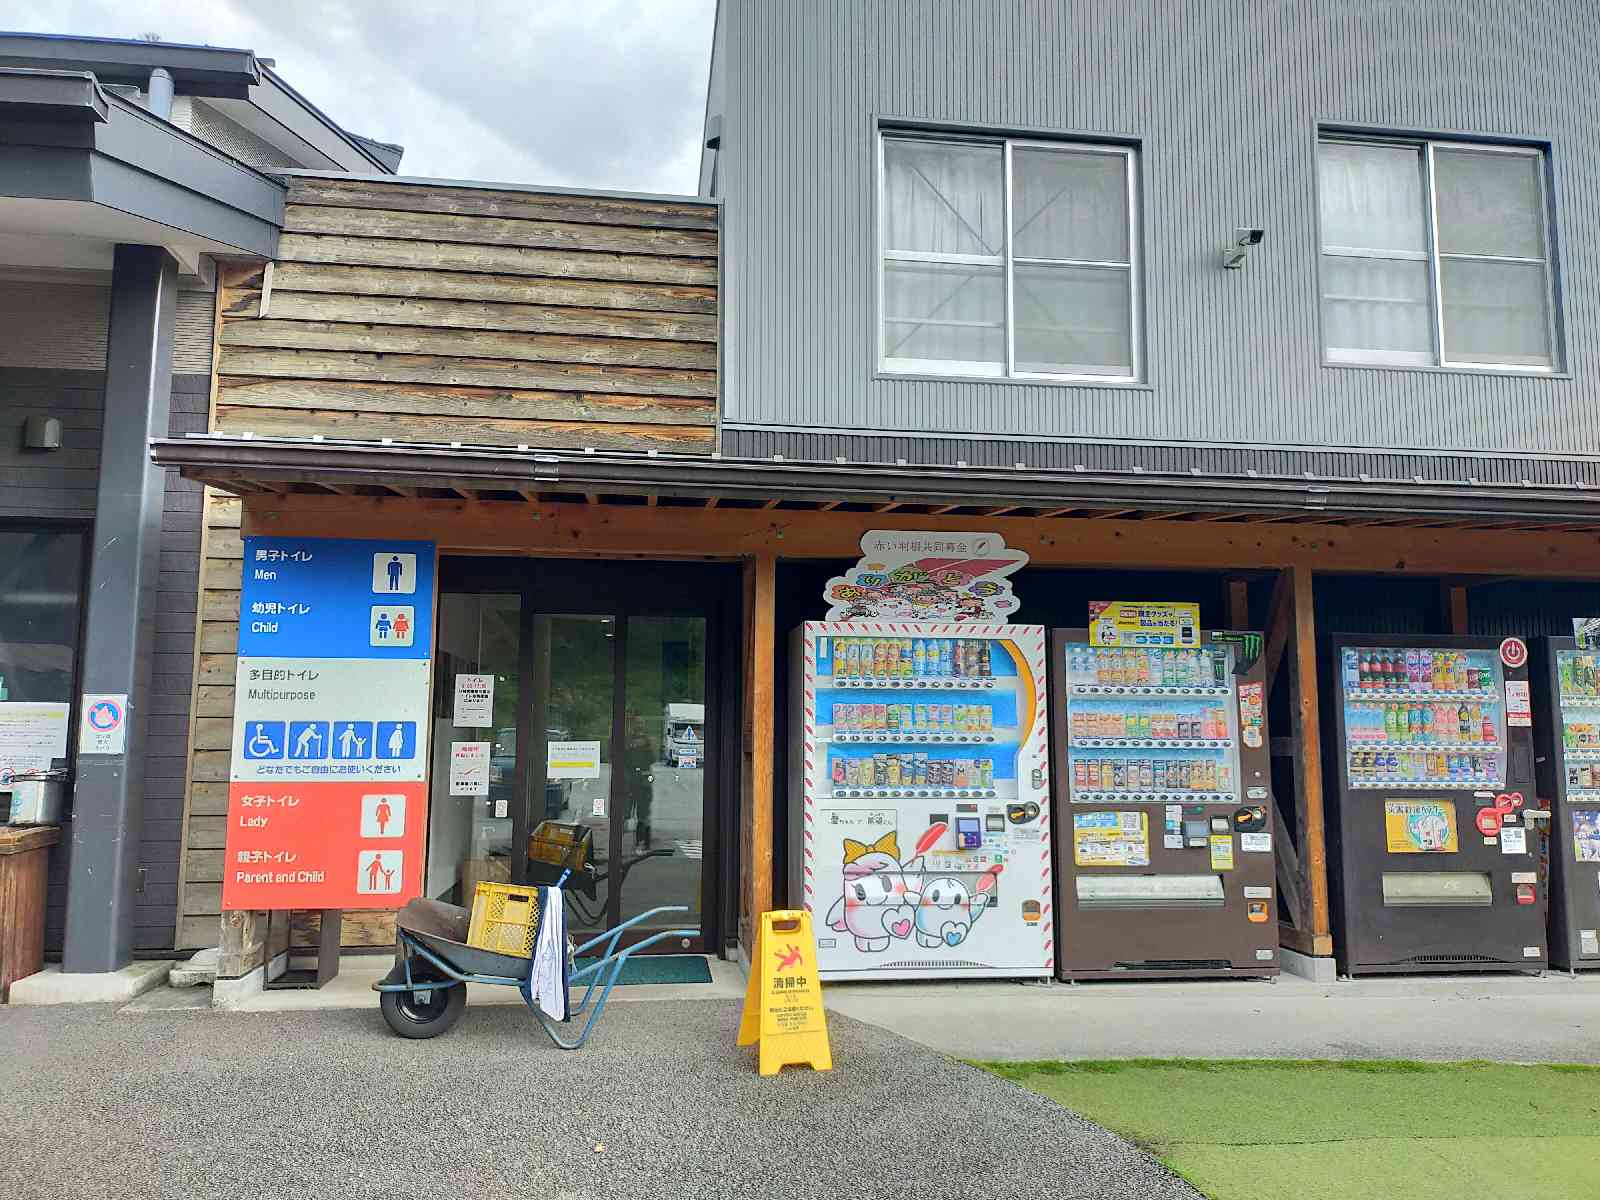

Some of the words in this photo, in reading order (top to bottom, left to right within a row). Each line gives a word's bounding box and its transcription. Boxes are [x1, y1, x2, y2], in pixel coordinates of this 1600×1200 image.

[255, 549, 313, 562] 男子トイレ
[254, 569, 277, 580] Men
[251, 602, 310, 615] 幼児トイレ
[251, 622, 278, 633] Child
[249, 669, 319, 681] 多目的トイレ
[248, 689, 316, 702] Multipurpose
[256, 765, 401, 775] どなたでもご自由にお使いください
[241, 795, 300, 807] 女子トイレ
[239, 816, 268, 829] Lady
[237, 851, 297, 864] 親子トイレ
[236, 871, 273, 883] Parent
[275, 871, 296, 883] and
[297, 870, 325, 883] Child
[773, 976, 807, 989] 清掃中
